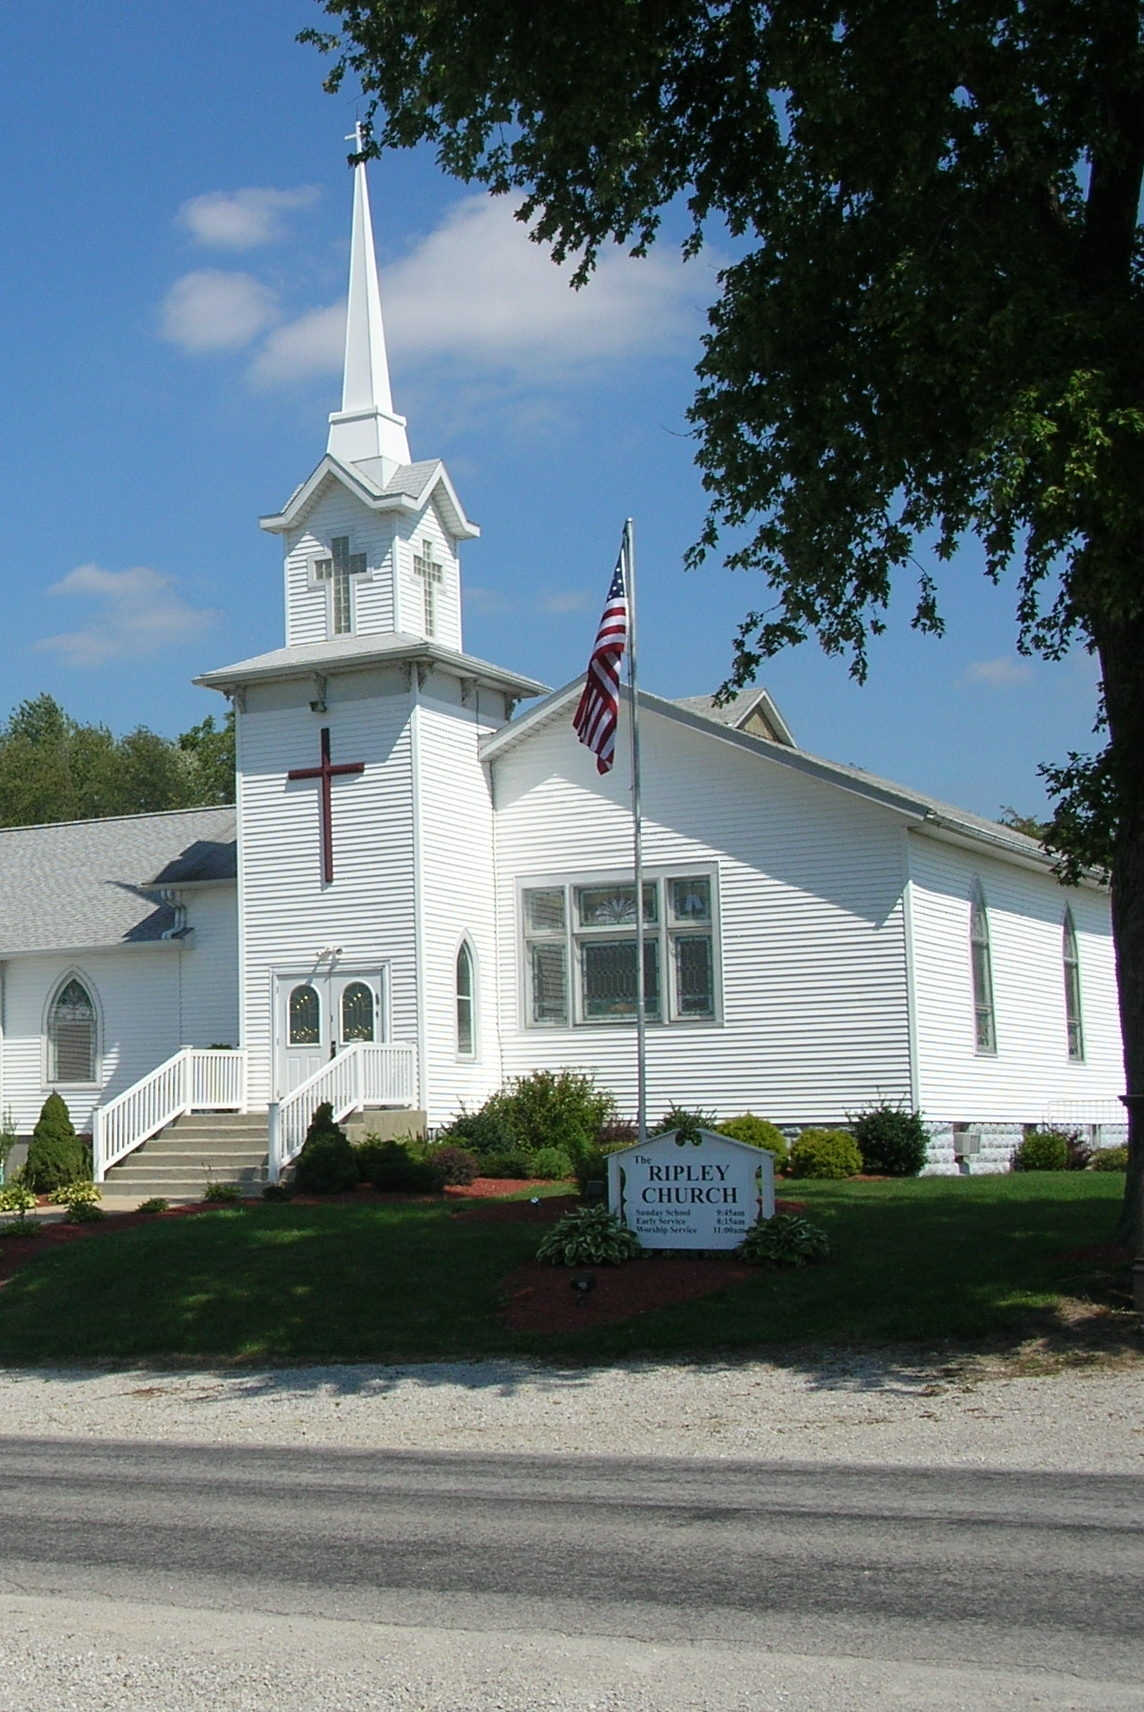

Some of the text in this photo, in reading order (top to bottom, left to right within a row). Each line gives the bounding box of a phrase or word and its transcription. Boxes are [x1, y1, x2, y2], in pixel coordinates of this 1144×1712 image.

[634, 1155, 652, 1164] The
[649, 1165, 730, 1181] RIPLEY
[642, 1187, 737, 1204] CHURCH
[636, 1208, 663, 1217] Sunday
[665, 1208, 691, 1216] School
[636, 1217, 656, 1226] Early
[659, 1217, 686, 1225] Service
[636, 1226, 668, 1235] Worship
[670, 1225, 697, 1234] Service
